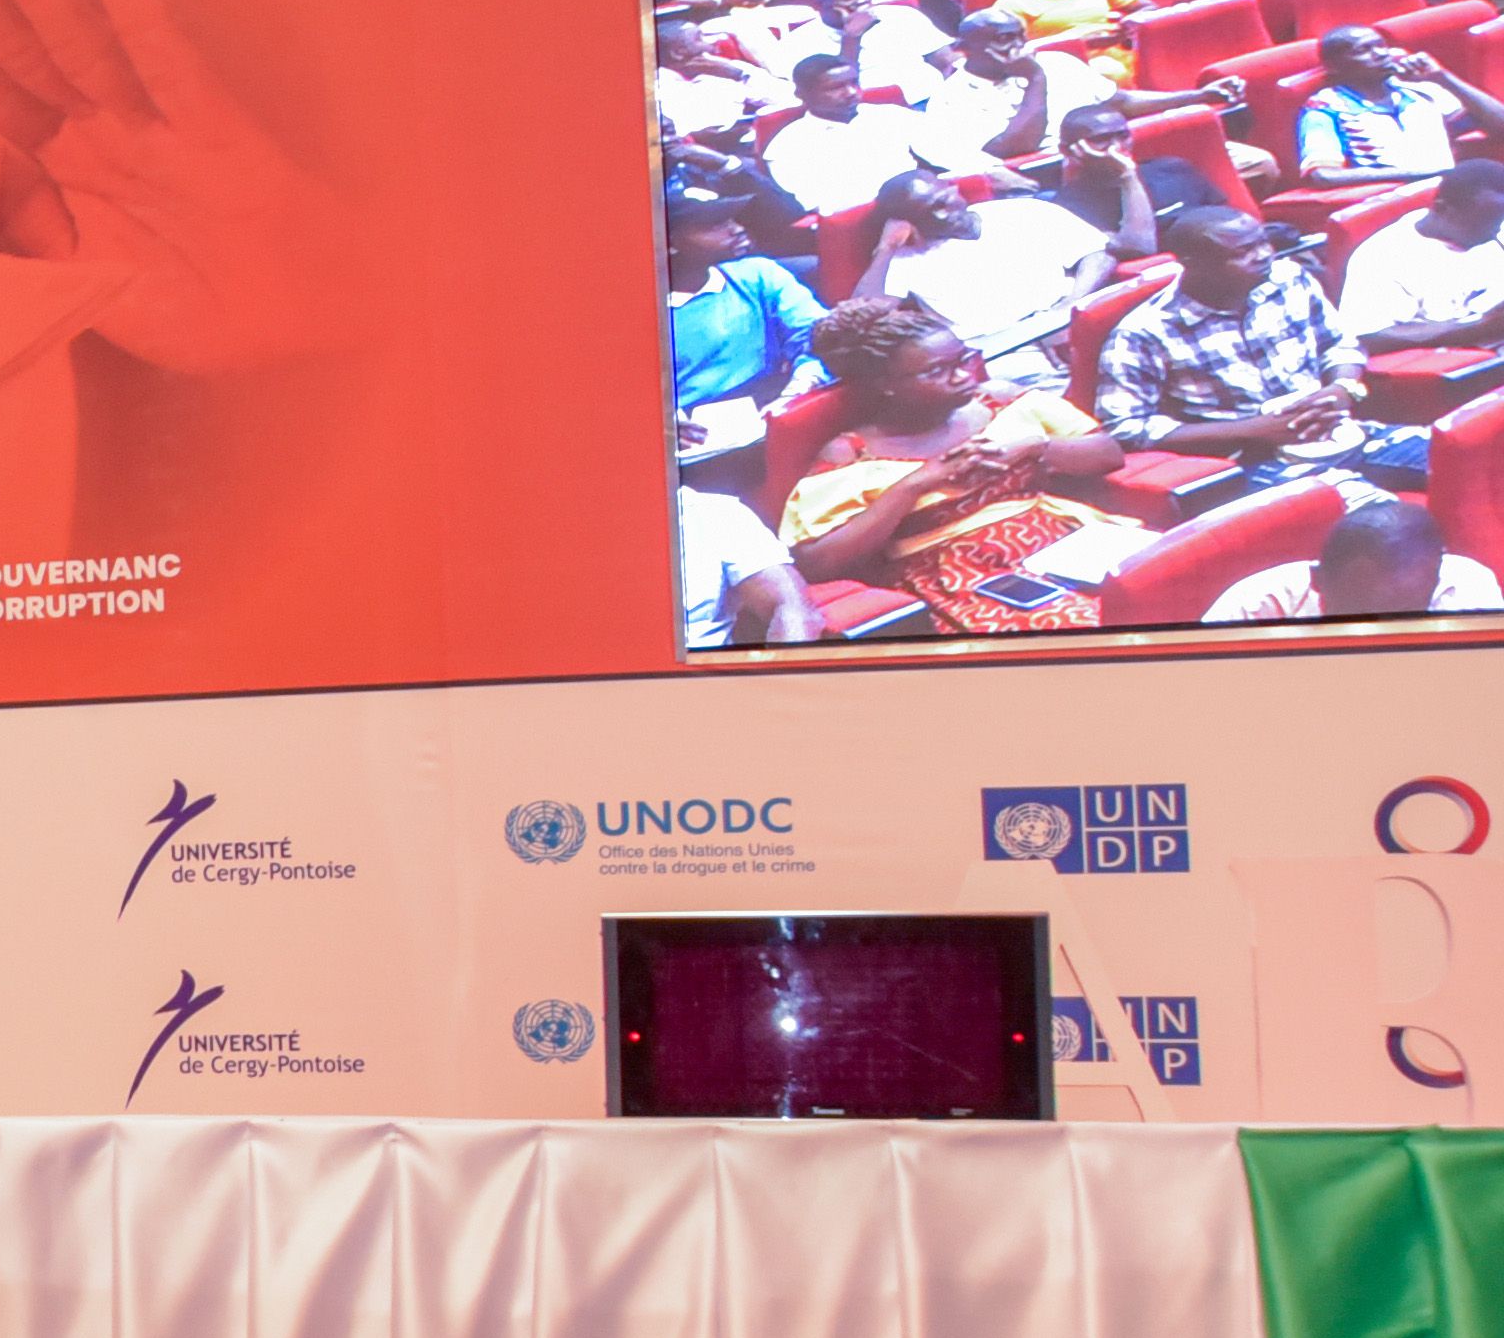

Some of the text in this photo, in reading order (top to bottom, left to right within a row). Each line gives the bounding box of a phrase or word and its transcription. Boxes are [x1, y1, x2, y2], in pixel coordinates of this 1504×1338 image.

[597, 798, 792, 836] UNODC
[171, 837, 292, 861] UNIVERSITÉ
[599, 843, 794, 859] Office des Nations Unies
[172, 861, 356, 885] de Cergy-Pontoise
[599, 860, 815, 877] contre la drogue et le crime
